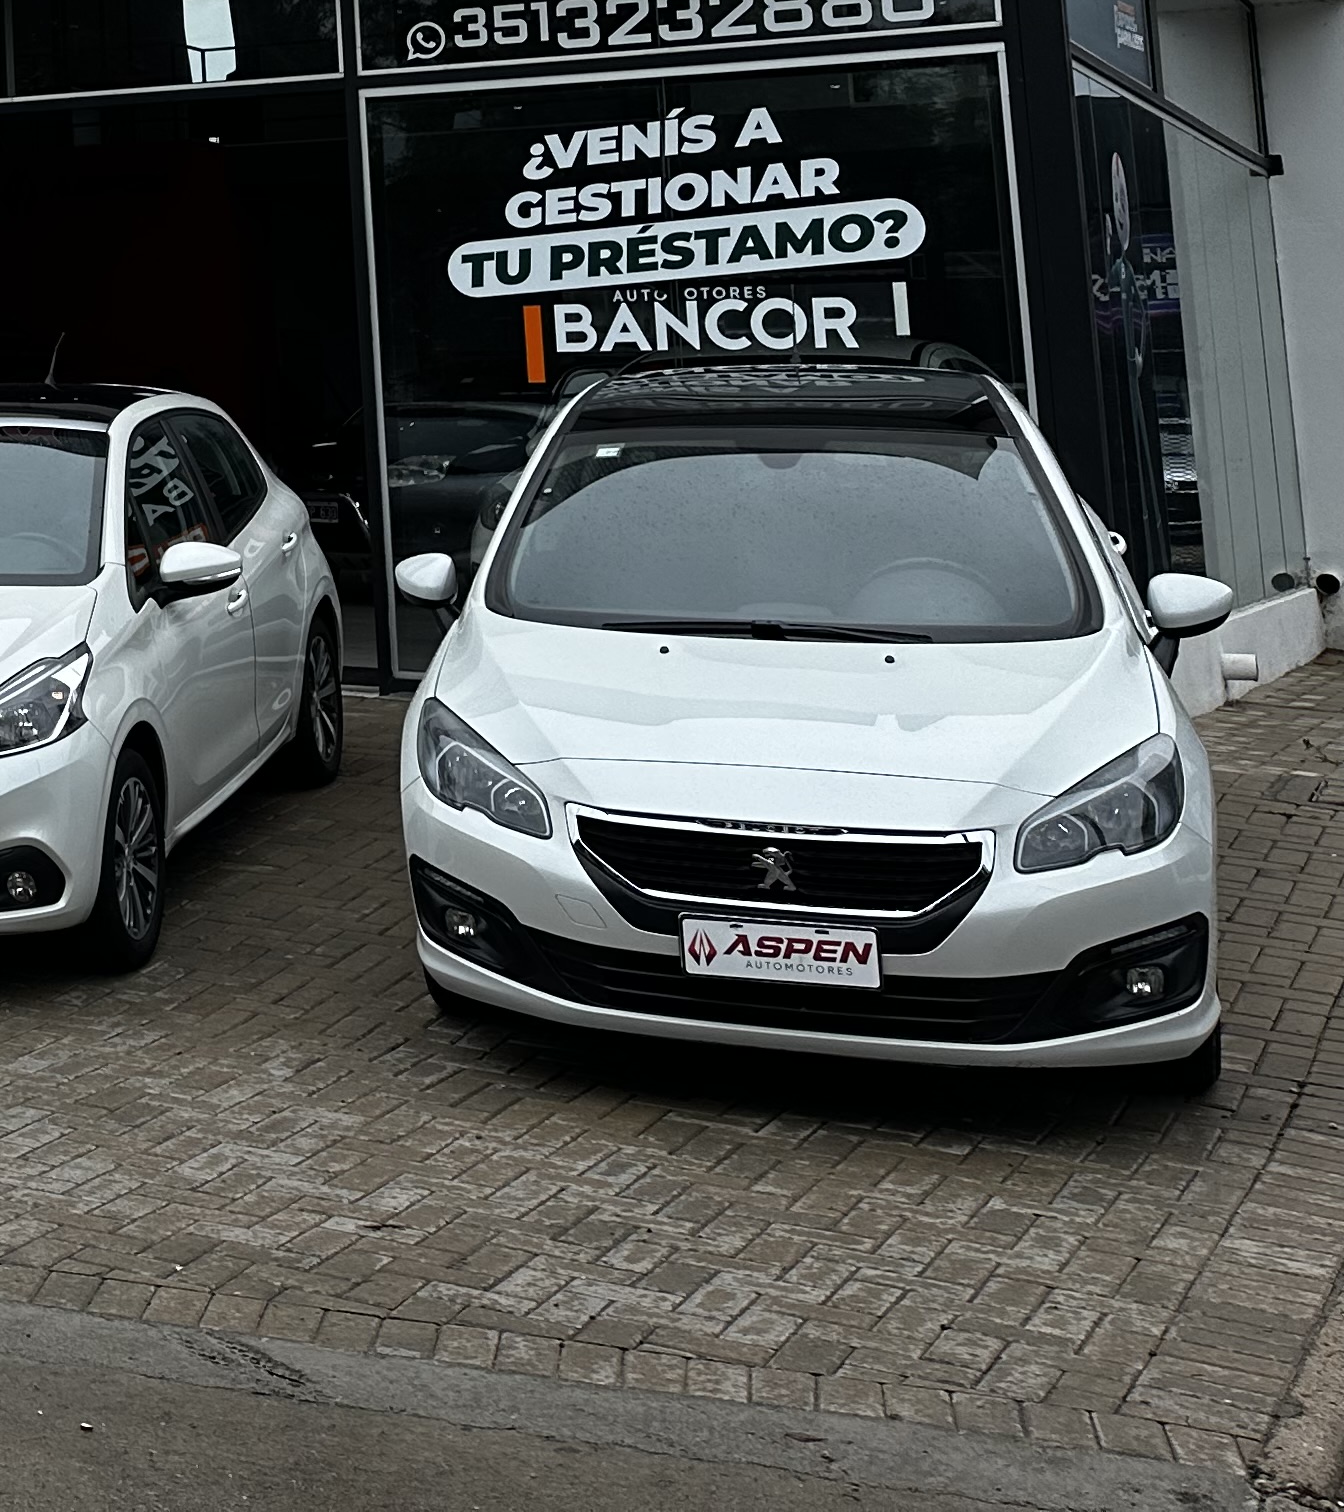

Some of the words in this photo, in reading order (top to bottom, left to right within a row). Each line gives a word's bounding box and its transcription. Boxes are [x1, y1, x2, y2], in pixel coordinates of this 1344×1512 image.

[522, 108, 717, 180] ¿VENÍS
[734, 108, 783, 147] A
[505, 157, 841, 229] GESTIONAR
[460, 249, 533, 289] TU
[549, 209, 909, 281] PRÉSTAMO?
[553, 298, 860, 353] BANCOR
[723, 933, 873, 966] ASPEN
[745, 960, 854, 977] AUTOMOTORES
